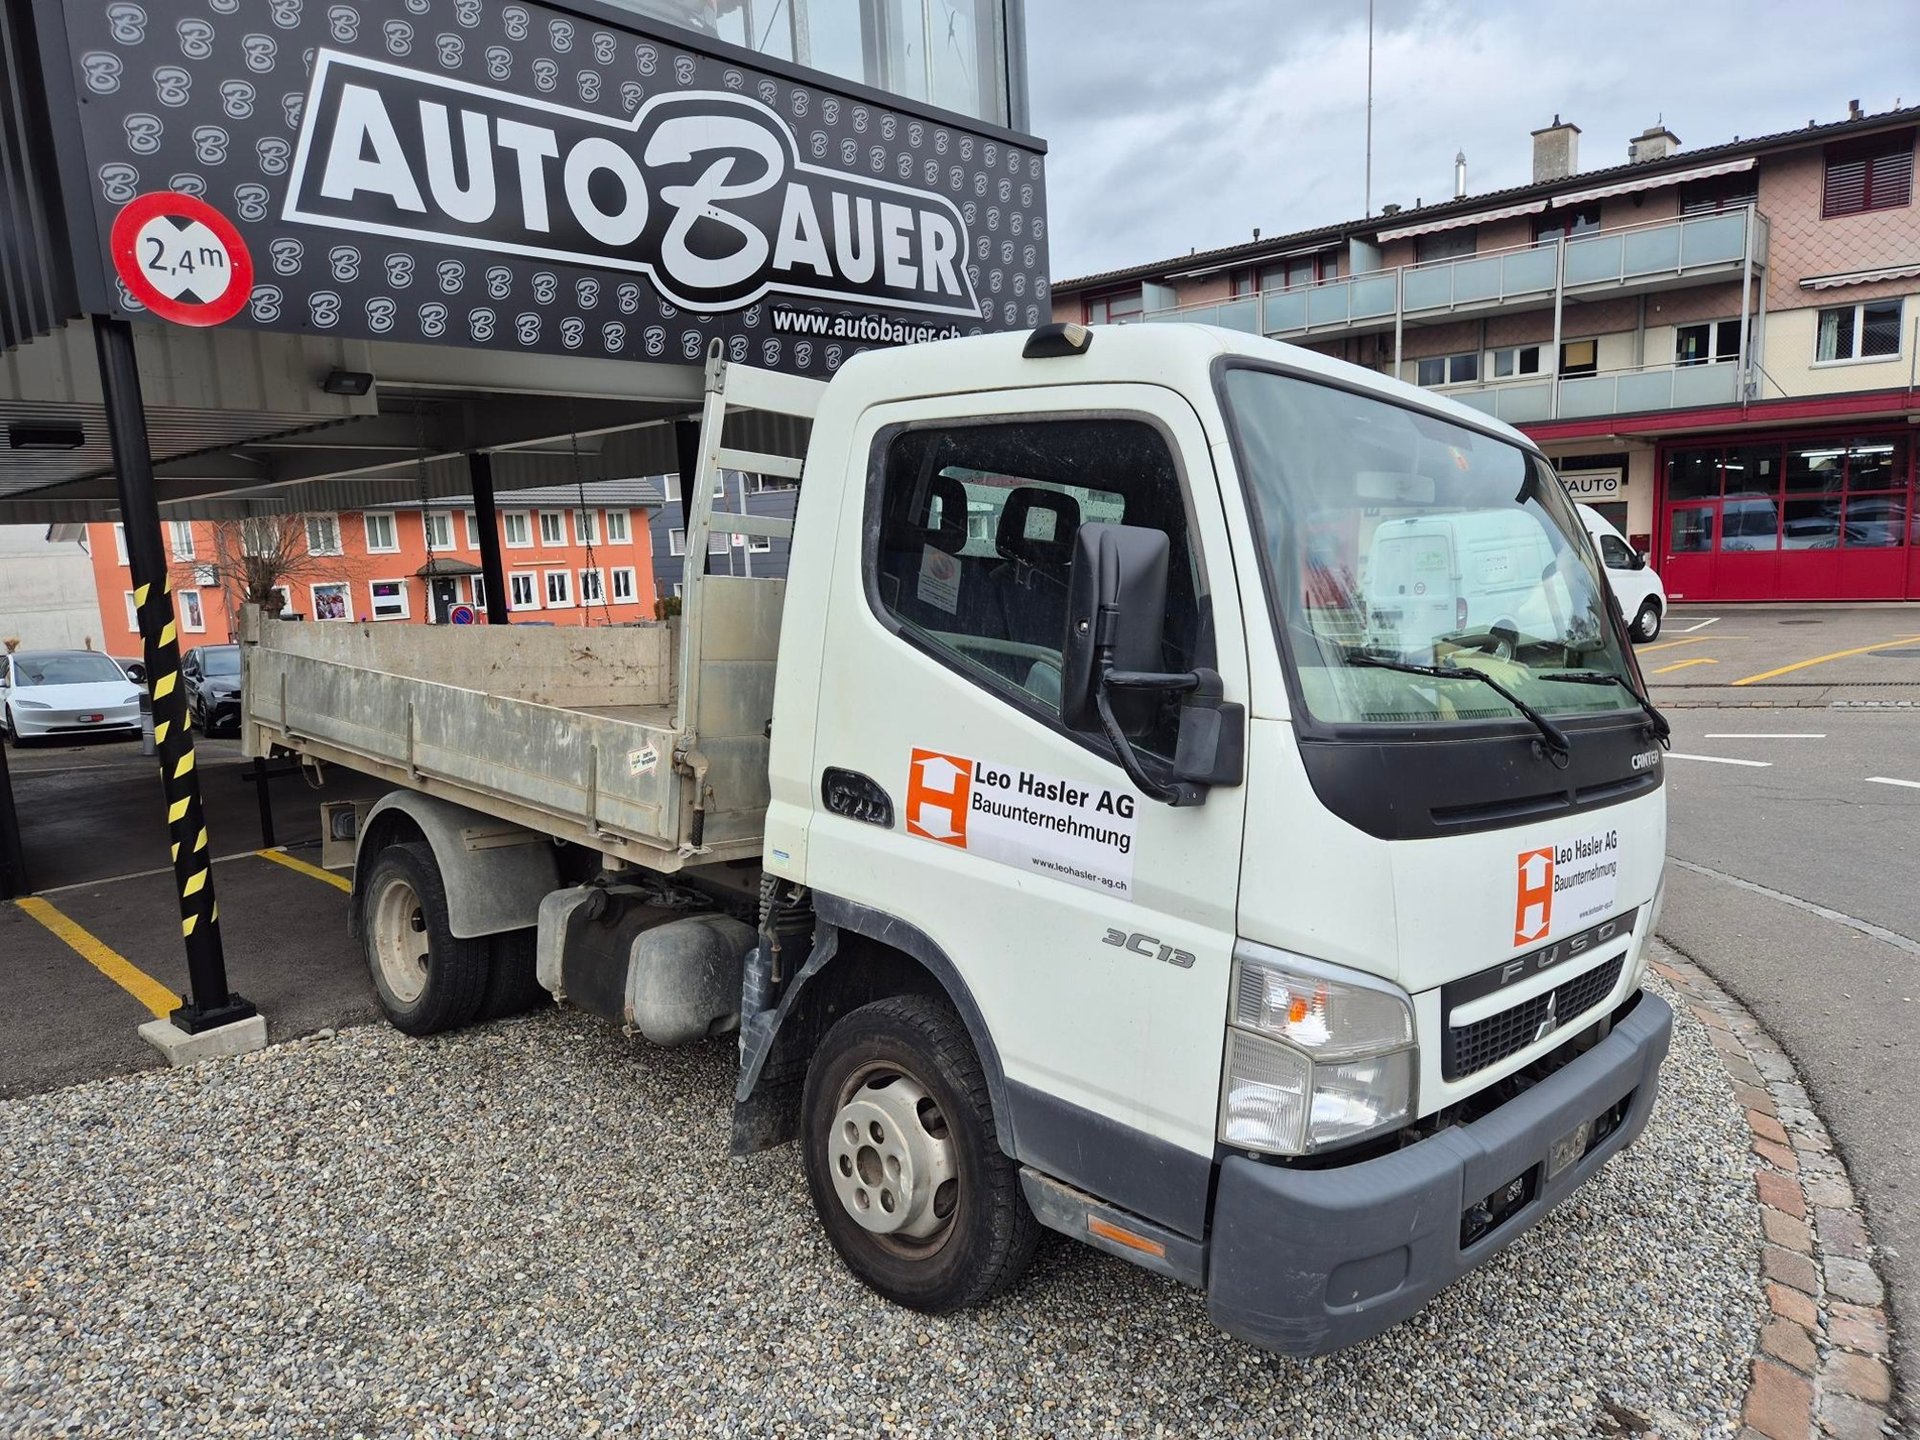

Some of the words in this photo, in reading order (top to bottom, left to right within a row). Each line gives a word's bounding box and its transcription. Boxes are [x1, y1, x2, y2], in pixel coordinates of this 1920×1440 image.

[320, 84, 649, 246] AUTO
[644, 116, 962, 297] BAUER
[773, 310, 961, 344] www.autobauer.ch
[1563, 479, 1617, 493] AUTO
[1631, 750, 1660, 770] CANTER
[975, 762, 1011, 790] Leo
[1018, 771, 1089, 808] Hasler
[1096, 790, 1135, 819] AG
[972, 792, 1131, 854] Bauunternehmung
[1554, 845, 1572, 865] Leo
[1575, 836, 1603, 860] Hasler
[1605, 830, 1618, 851] AG
[1032, 856, 1127, 891] www.leohasler-ag.ch
[1554, 861, 1617, 892] Bauunternehmung
[1102, 928, 1196, 969] 3C13
[1501, 922, 1616, 984] FUSO
